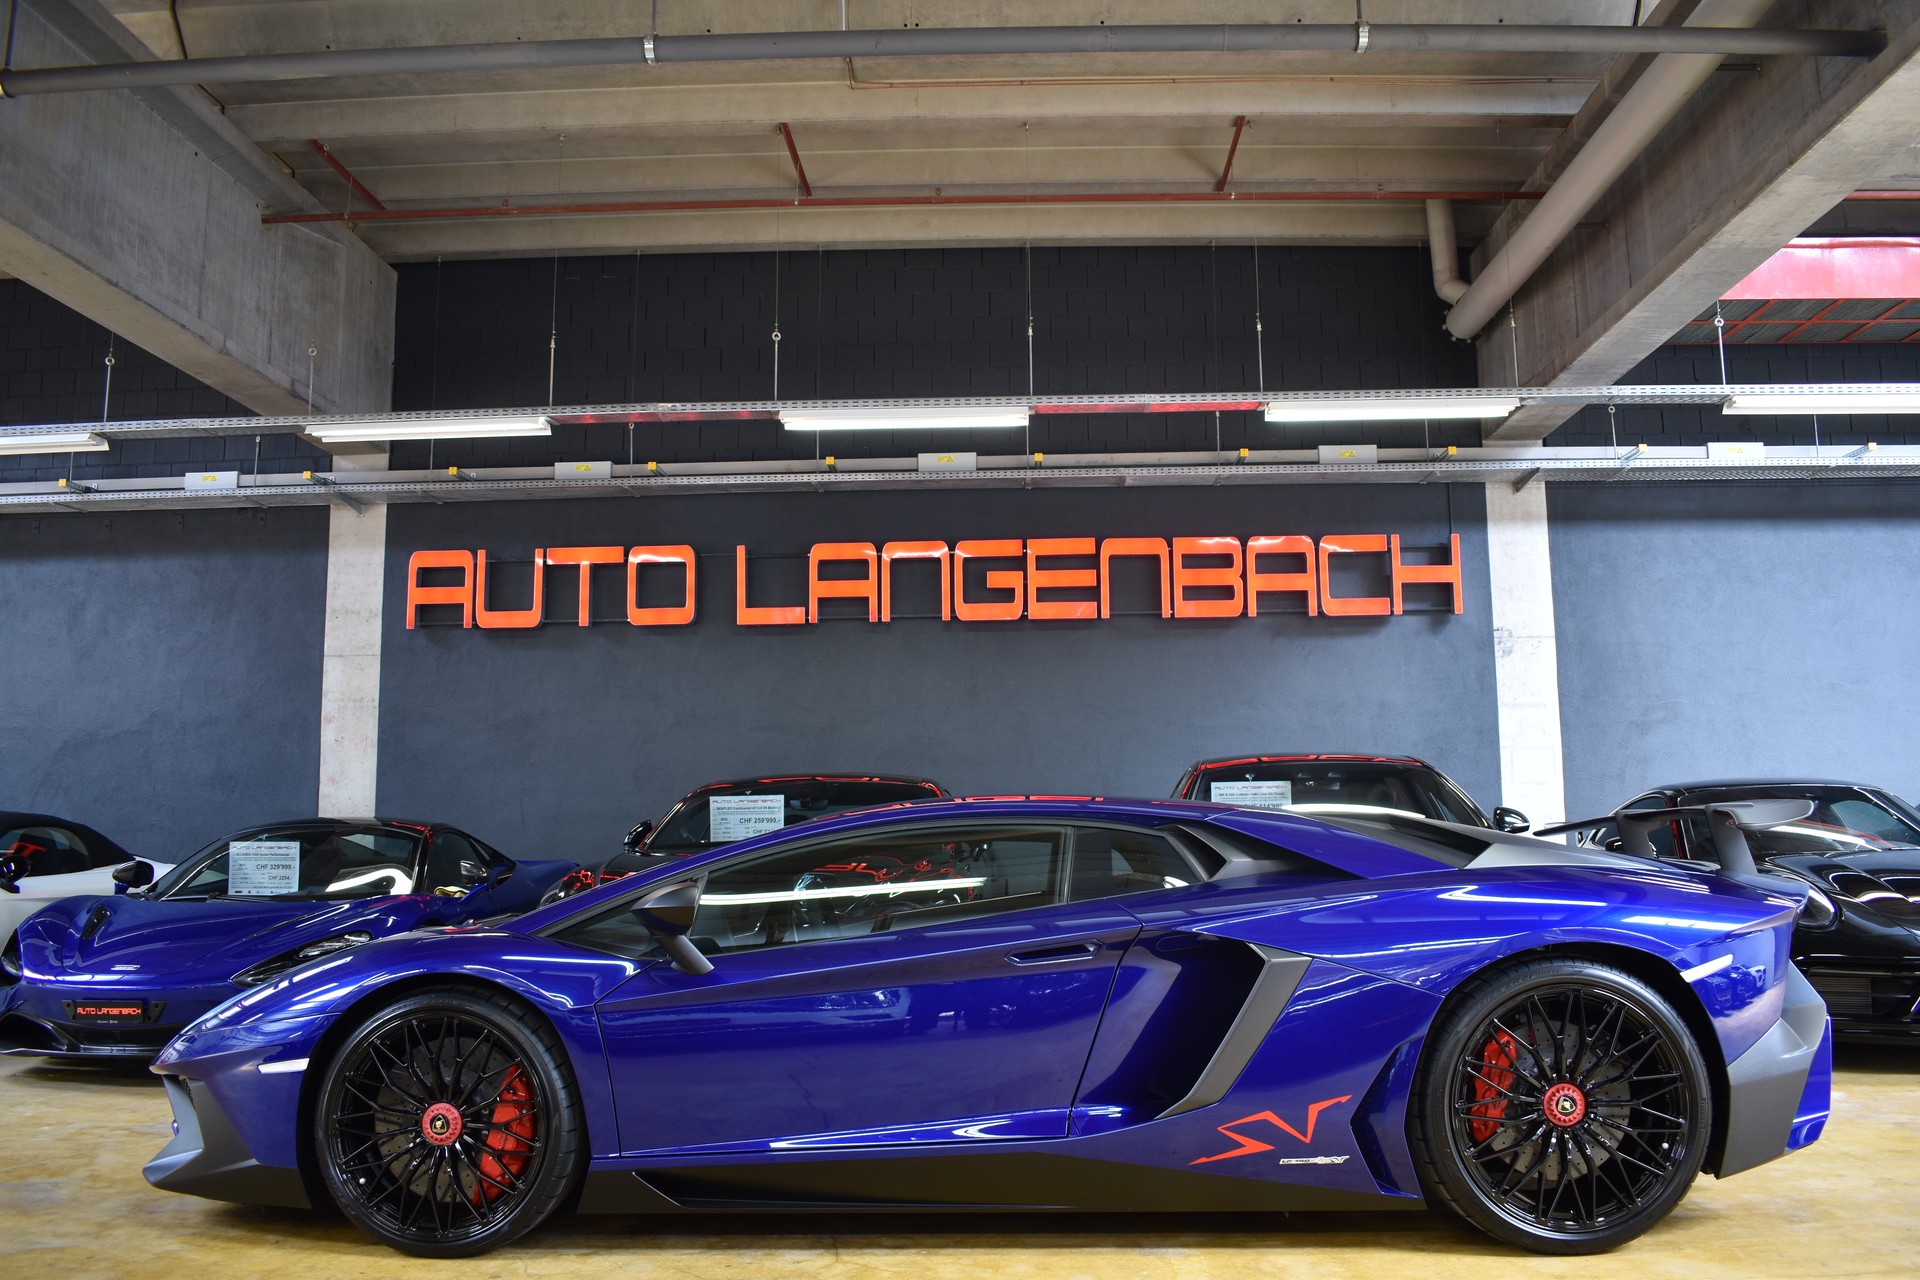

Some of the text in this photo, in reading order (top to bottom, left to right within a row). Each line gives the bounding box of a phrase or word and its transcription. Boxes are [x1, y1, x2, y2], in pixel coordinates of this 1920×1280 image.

[406, 533, 1464, 630] AUTO LANGENBACH
[76, 1007, 142, 1015] AUTO LANGENBACH
